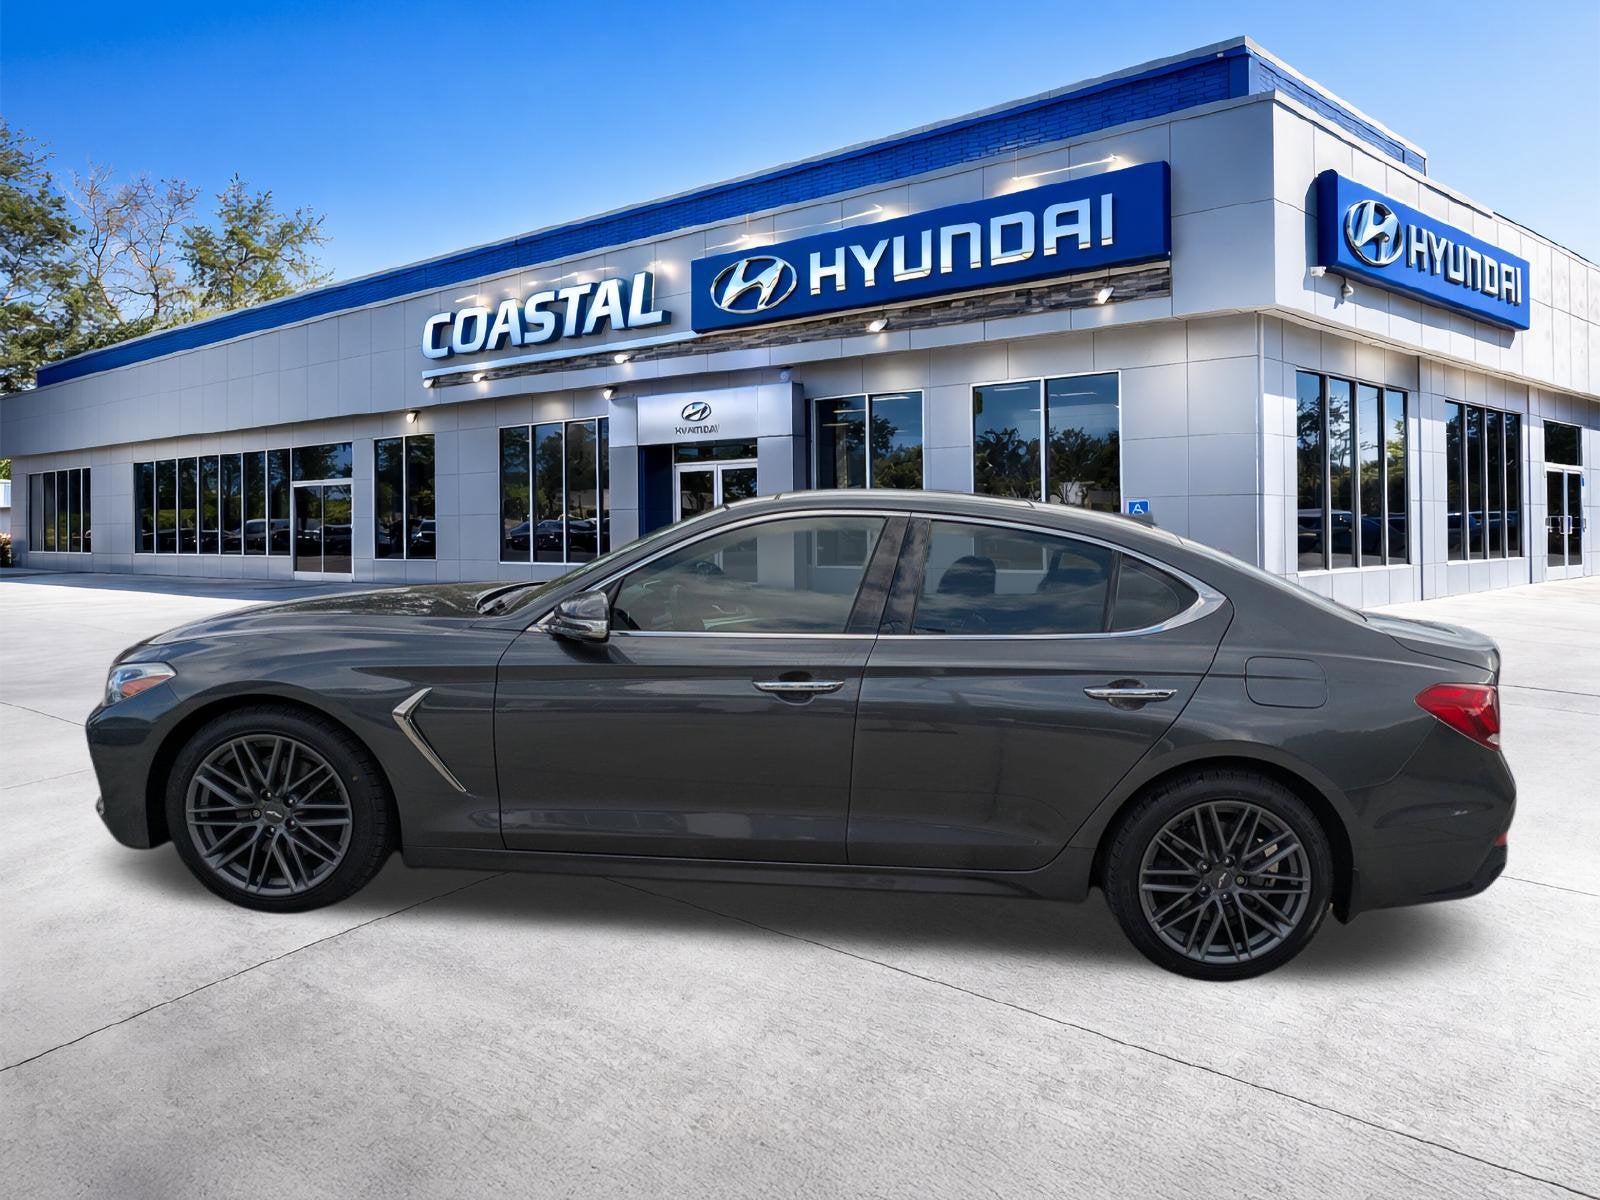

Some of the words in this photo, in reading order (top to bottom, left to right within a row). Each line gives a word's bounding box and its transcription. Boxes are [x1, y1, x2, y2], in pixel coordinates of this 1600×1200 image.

[809, 192, 1114, 296] HYUNDAI
[1406, 224, 1522, 306] HYUNDAI
[421, 271, 666, 360] COASTAL
